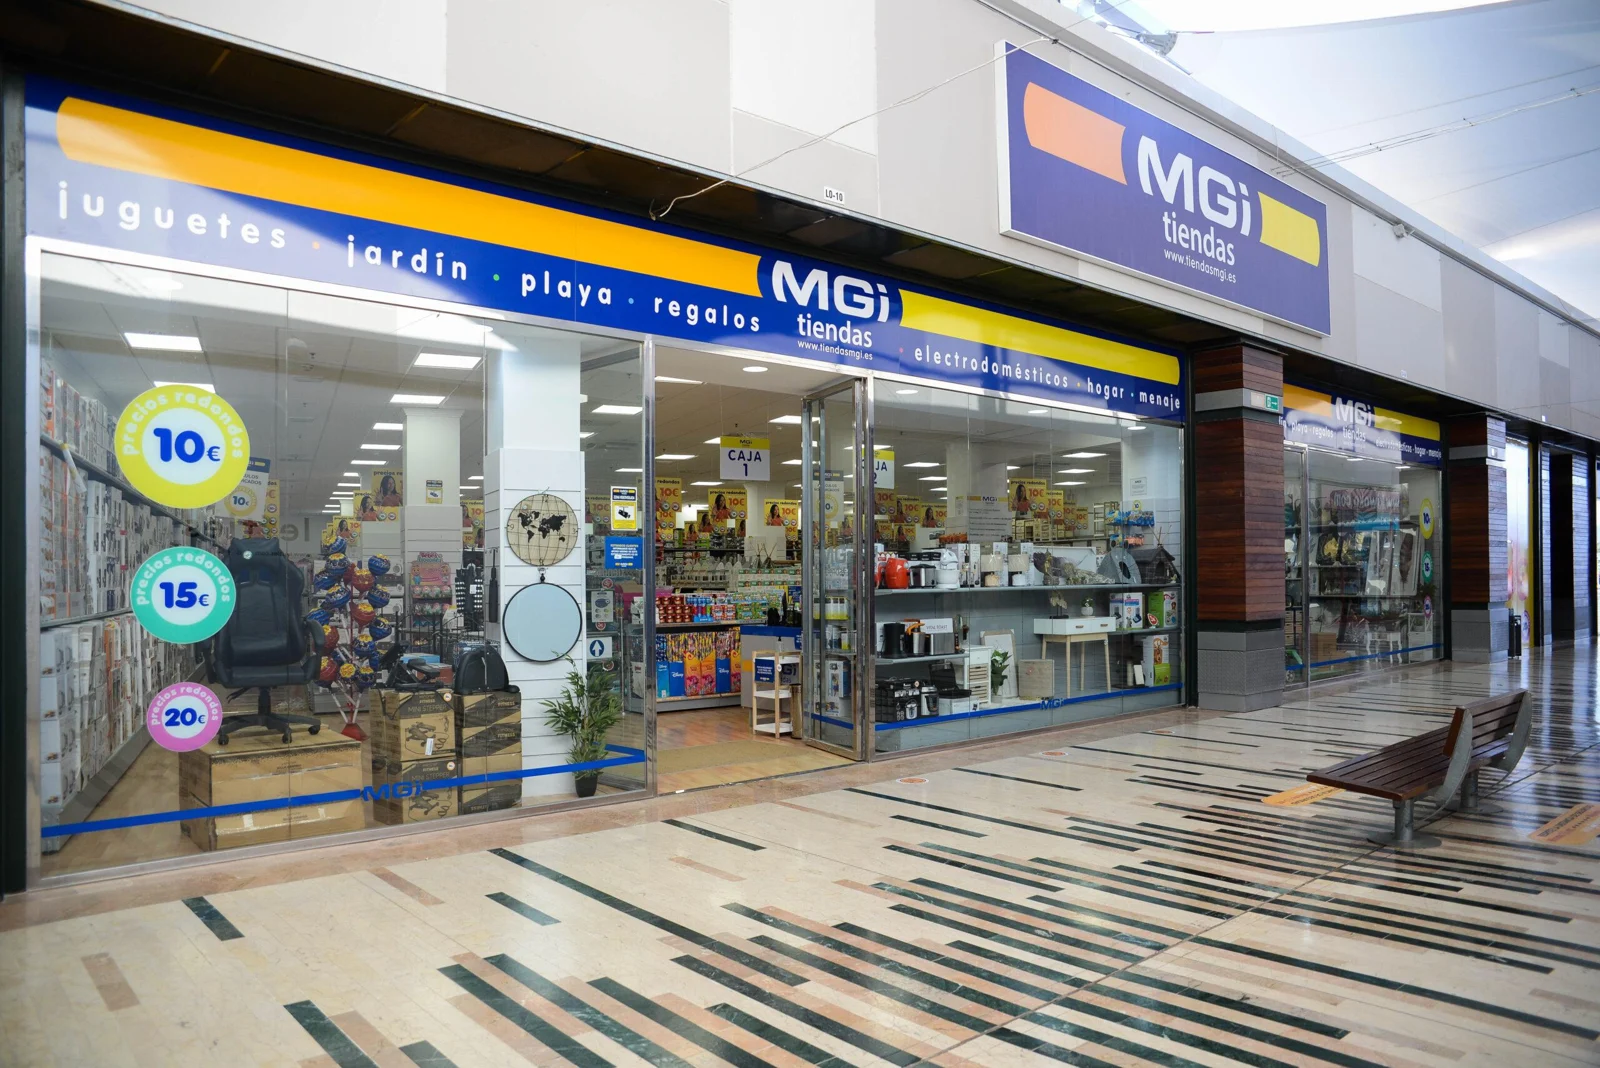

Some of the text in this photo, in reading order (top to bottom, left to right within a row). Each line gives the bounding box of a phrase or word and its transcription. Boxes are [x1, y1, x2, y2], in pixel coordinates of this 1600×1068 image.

[1137, 134, 1251, 236] MGi
[1162, 211, 1235, 266] tiendas
[58, 181, 760, 334] juguetes jardín playa regalos
[1163, 249, 1237, 283] www.tiendasmgi.es
[771, 260, 890, 323] MGi
[796, 313, 872, 348] tiendas
[797, 340, 873, 360] www.tiendasmgi.es
[914, 344, 1181, 412] electrodomésticos hogar menaje
[122, 391, 243, 459] precios redondos
[1291, 420, 1308, 434] playa
[1312, 424, 1334, 438] regalos
[1342, 425, 1366, 442] tiendas
[153, 427, 221, 463] 10€
[728, 450, 762, 462] CAJA
[743, 463, 748, 476] 1
[136, 551, 230, 605] precios redondos
[159, 581, 210, 609] 15€
[151, 686, 219, 726] precios redondos
[164, 707, 206, 727] 20€
